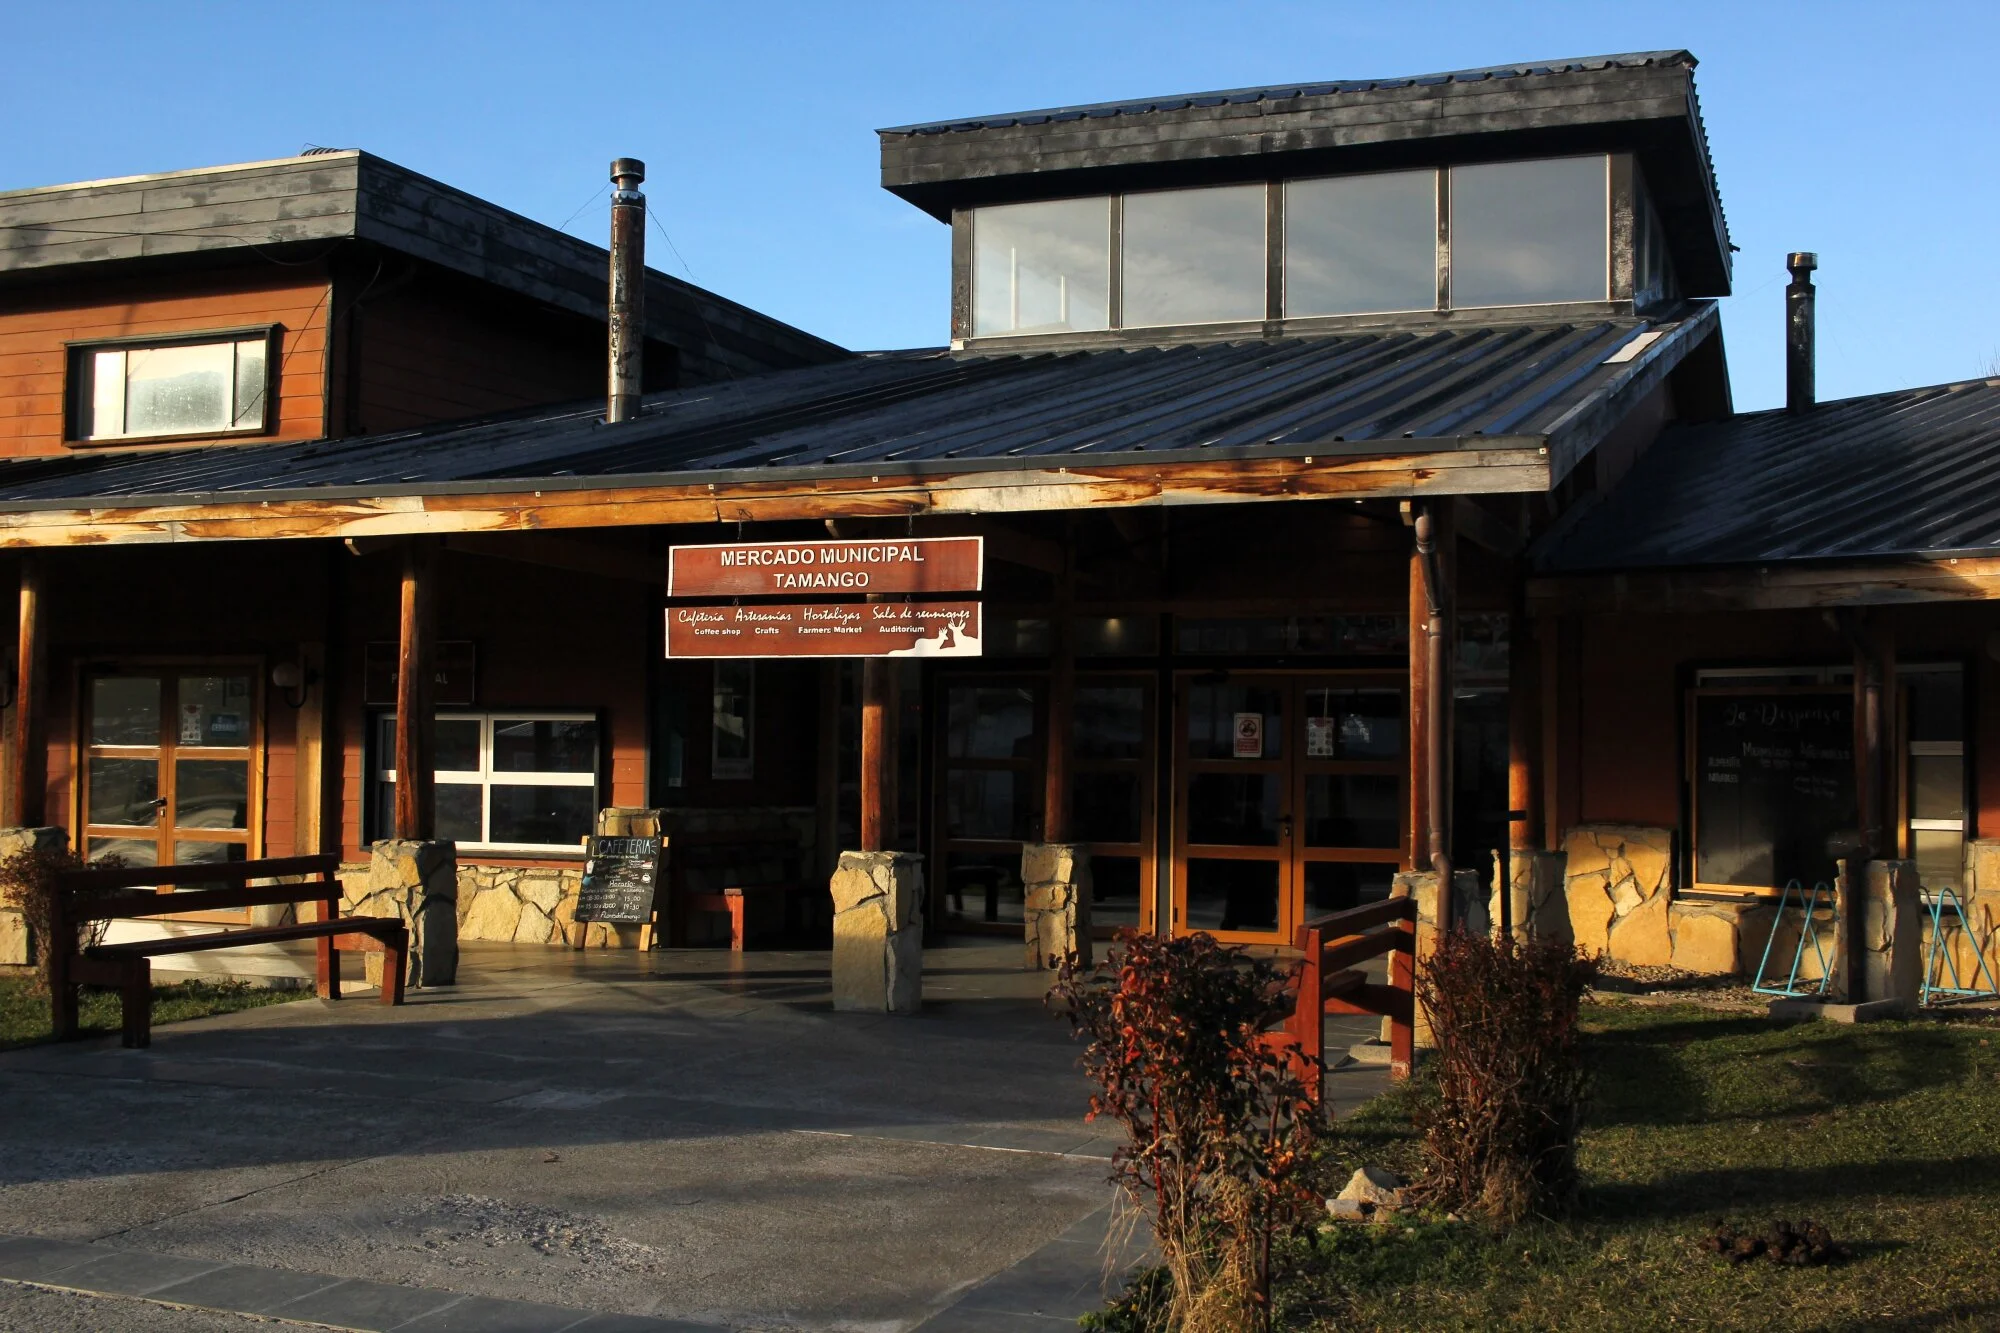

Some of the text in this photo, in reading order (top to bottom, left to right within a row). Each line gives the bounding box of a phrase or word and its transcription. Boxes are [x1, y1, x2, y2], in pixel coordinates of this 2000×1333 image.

[720, 545, 925, 566] MERCADO MUNICIPAL
[773, 571, 869, 588] TAMANGO
[803, 606, 861, 625] Hortalizas
[872, 605, 897, 620] Sala
[900, 606, 913, 619] de
[915, 608, 970, 619] reuniones
[722, 628, 741, 636] shop
[755, 627, 780, 635] Crafts
[798, 626, 831, 634] Farmers
[879, 625, 925, 633] Auditorium
